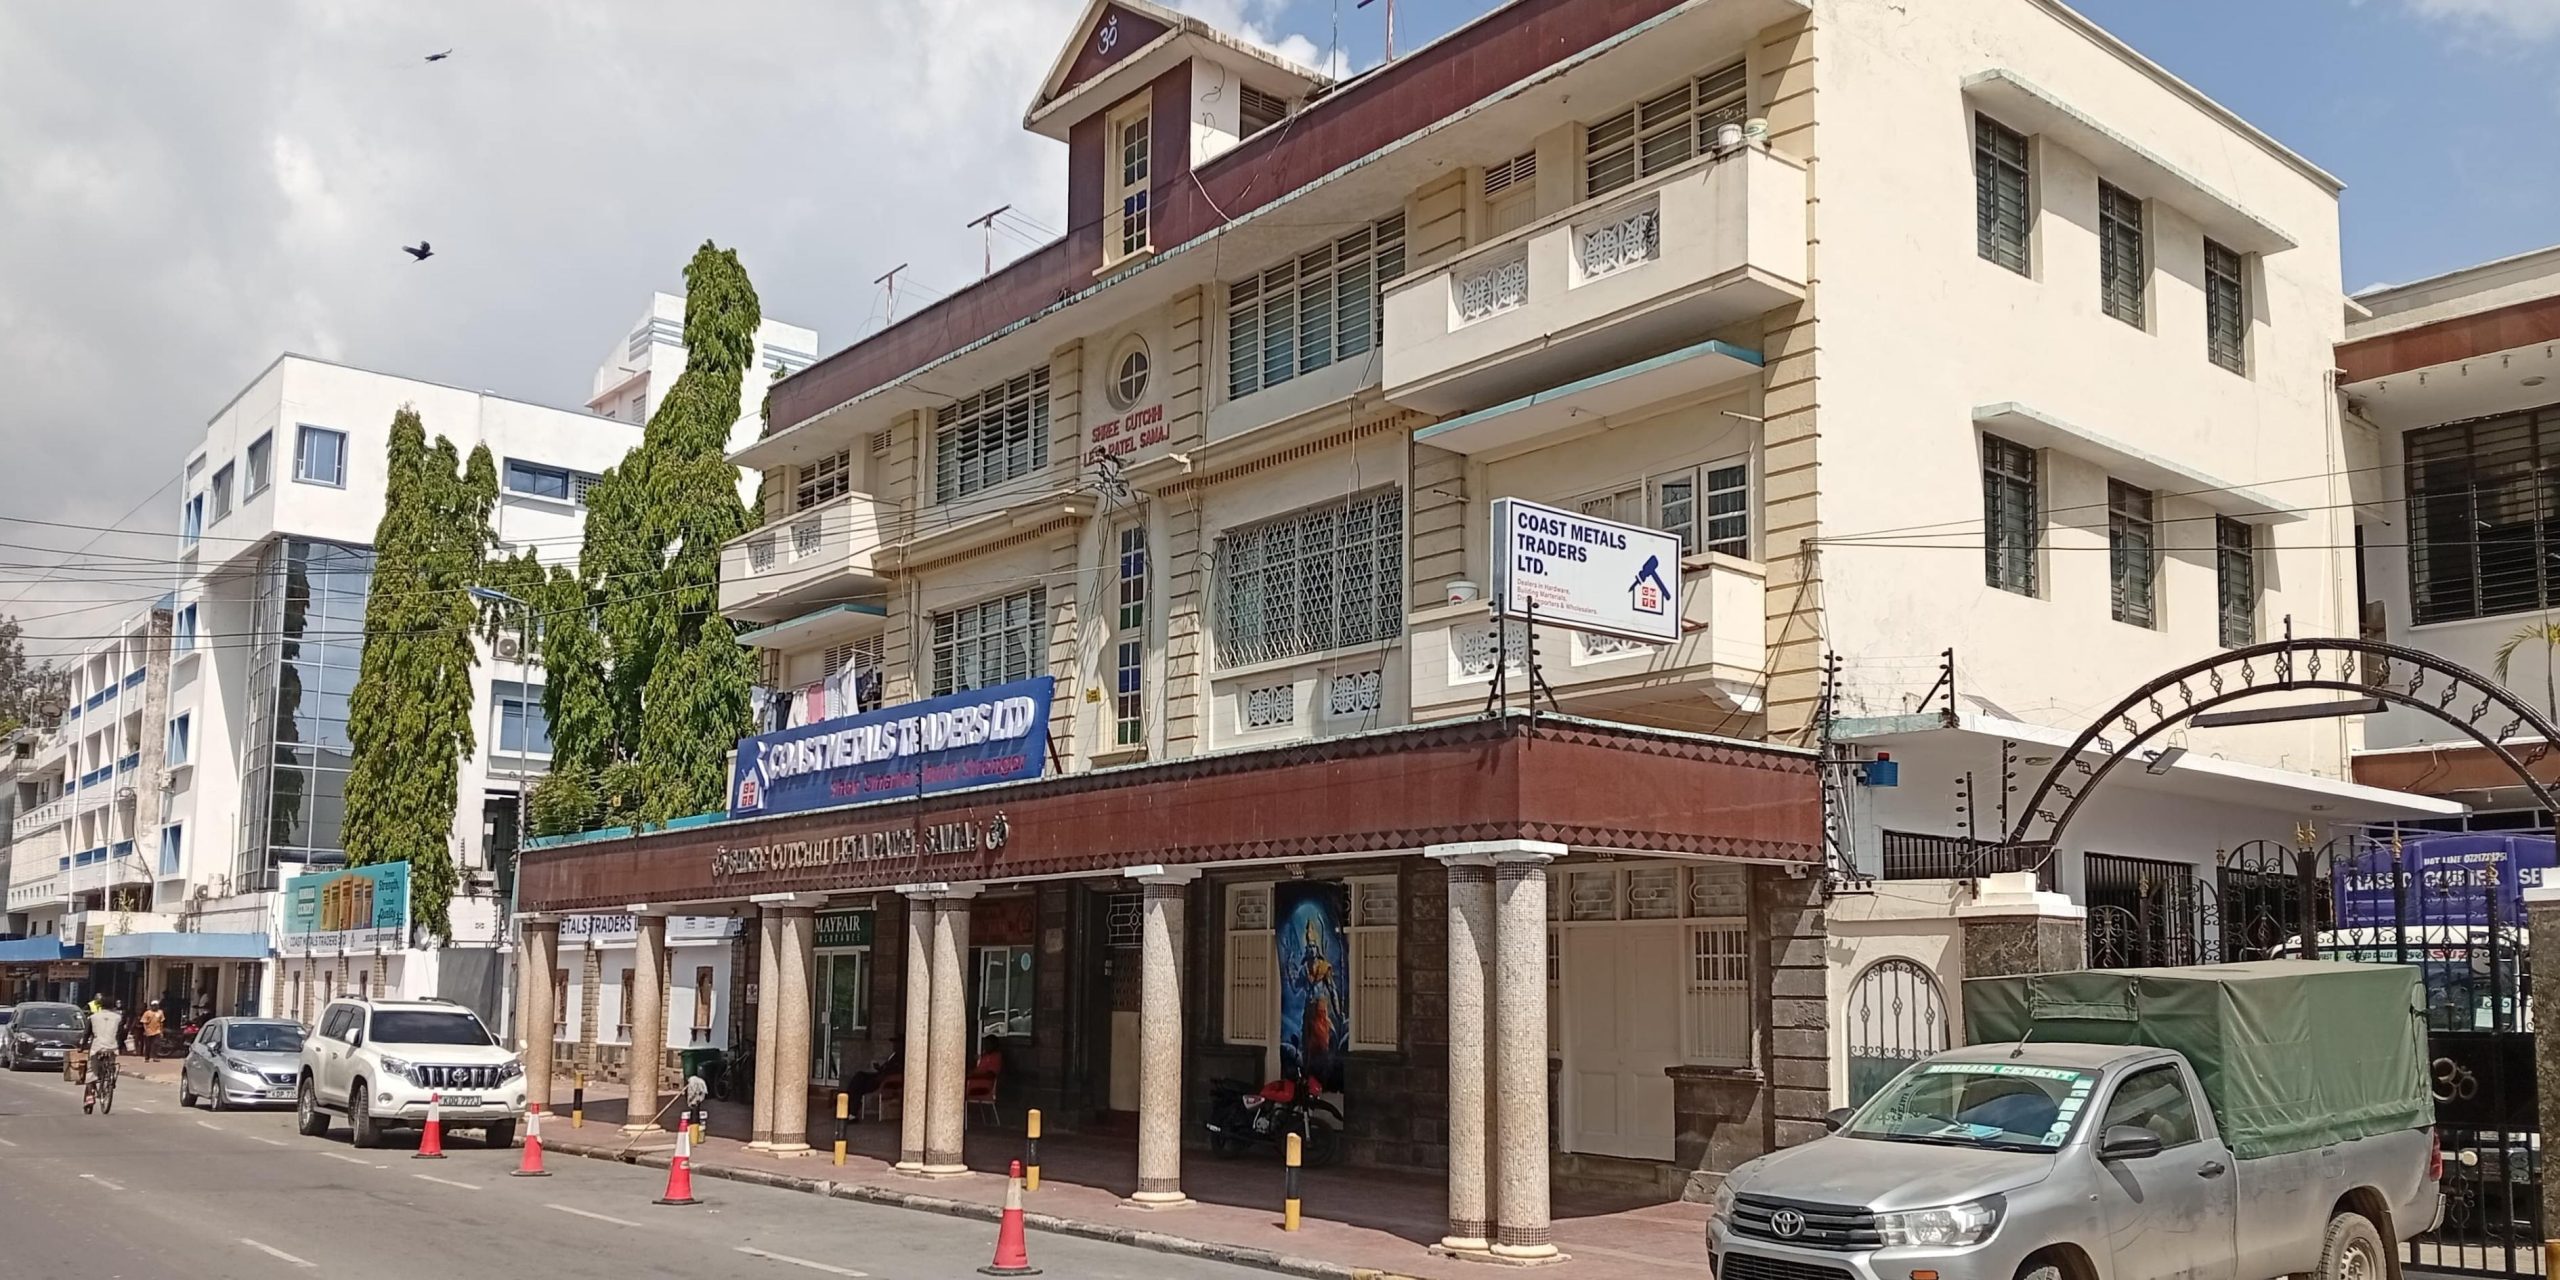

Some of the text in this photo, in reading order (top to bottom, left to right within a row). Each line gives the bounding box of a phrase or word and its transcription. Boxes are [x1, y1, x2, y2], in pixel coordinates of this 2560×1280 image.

[1092, 404, 1163, 443] SHREE CUTCHHI
[1108, 436, 1137, 457] PATEL
[1140, 423, 1170, 448] SAMAJ
[1518, 512, 1627, 550] COAST METALS
[1517, 533, 1588, 563] TRADERS
[1518, 554, 1548, 577] LTD.
[768, 696, 1035, 780] COAST METALS TRADERS LTD
[771, 839, 831, 870] CUTCHHI
[590, 914, 632, 933] TRADERS
[815, 915, 860, 932] MAYFAIR
[2000, 1066, 2076, 1081] CEMENT
